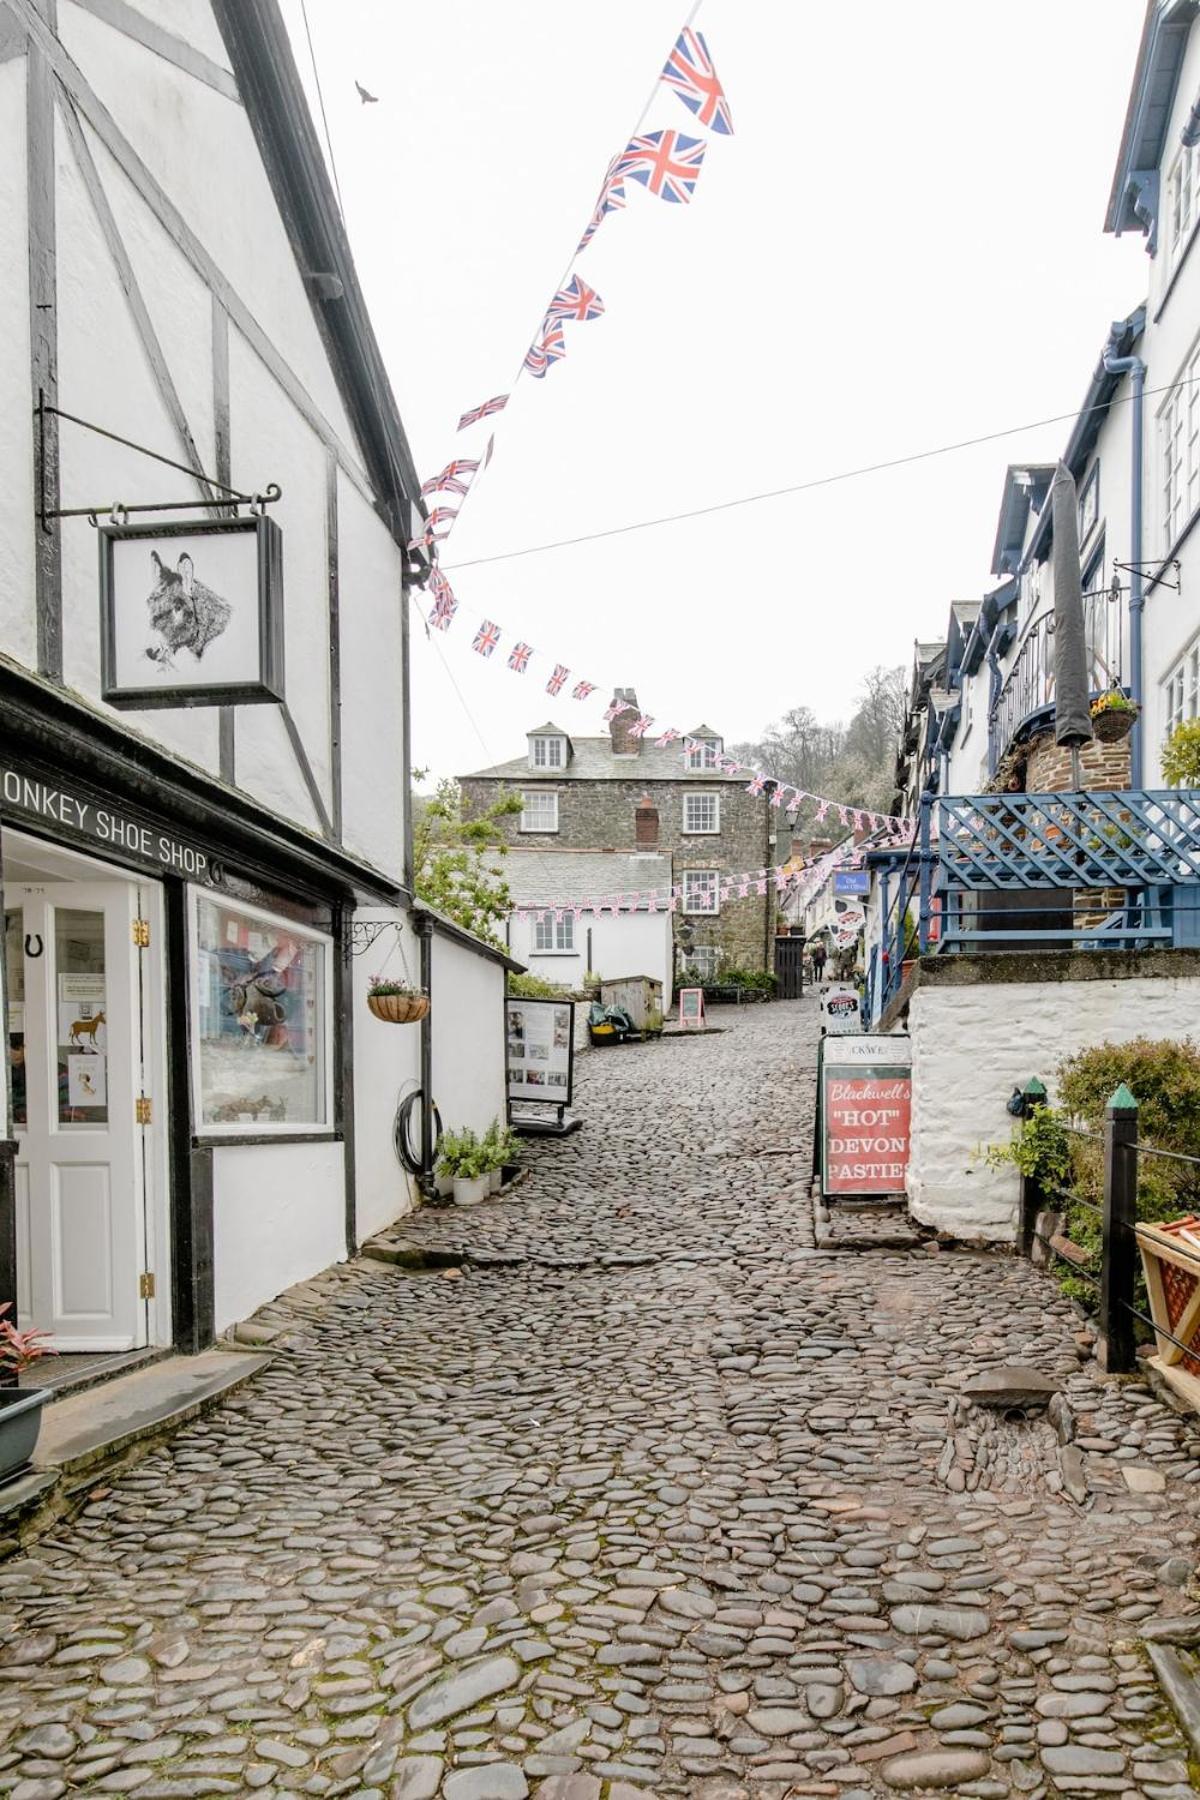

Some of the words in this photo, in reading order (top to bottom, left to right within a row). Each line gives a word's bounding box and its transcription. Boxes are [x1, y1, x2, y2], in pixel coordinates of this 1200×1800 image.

[96, 812, 153, 856] SHOE
[159, 837, 206, 874] SHOP
[834, 1109, 900, 1126] "HOT"
[828, 1137, 906, 1153] DEVON
